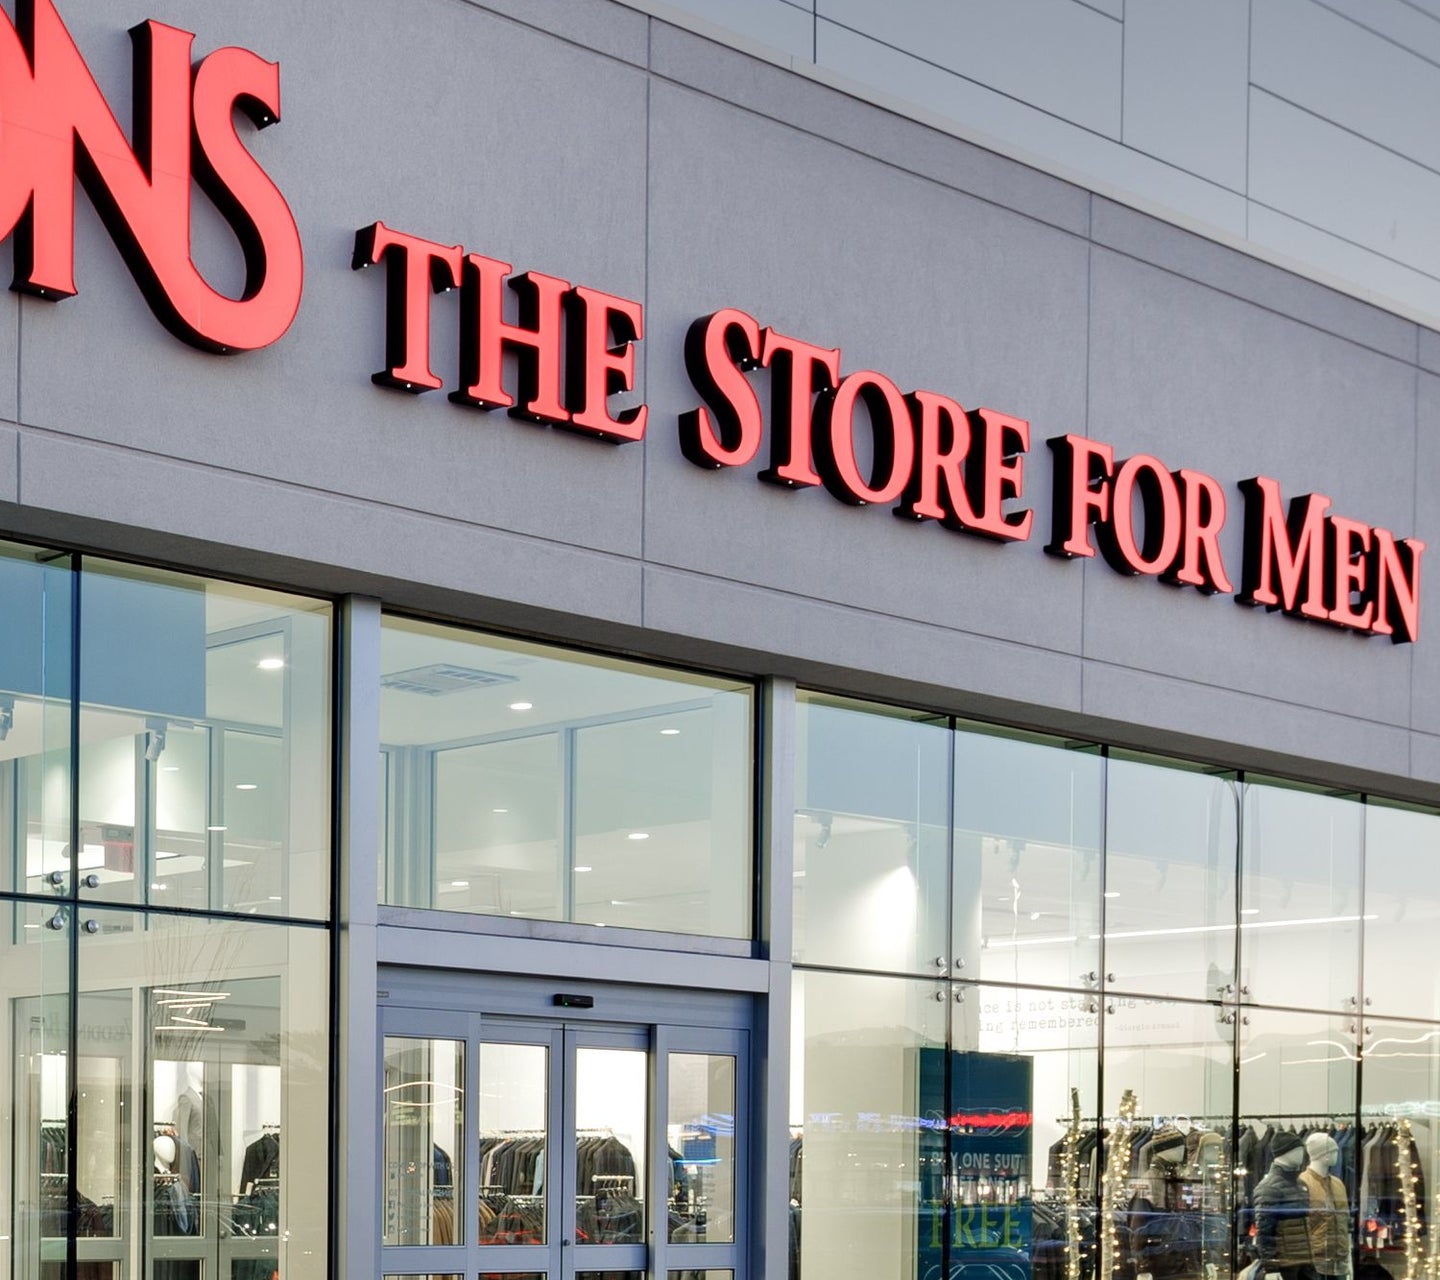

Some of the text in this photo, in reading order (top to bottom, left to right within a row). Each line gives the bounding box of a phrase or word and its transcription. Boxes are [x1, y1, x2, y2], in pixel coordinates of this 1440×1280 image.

[353, 221, 1426, 643] THE STORE FOR MEN
[1028, 997, 1055, 1012] not
[932, 1151, 1021, 1169] BY ONE SUIT
[929, 1199, 1024, 1249] FREE
